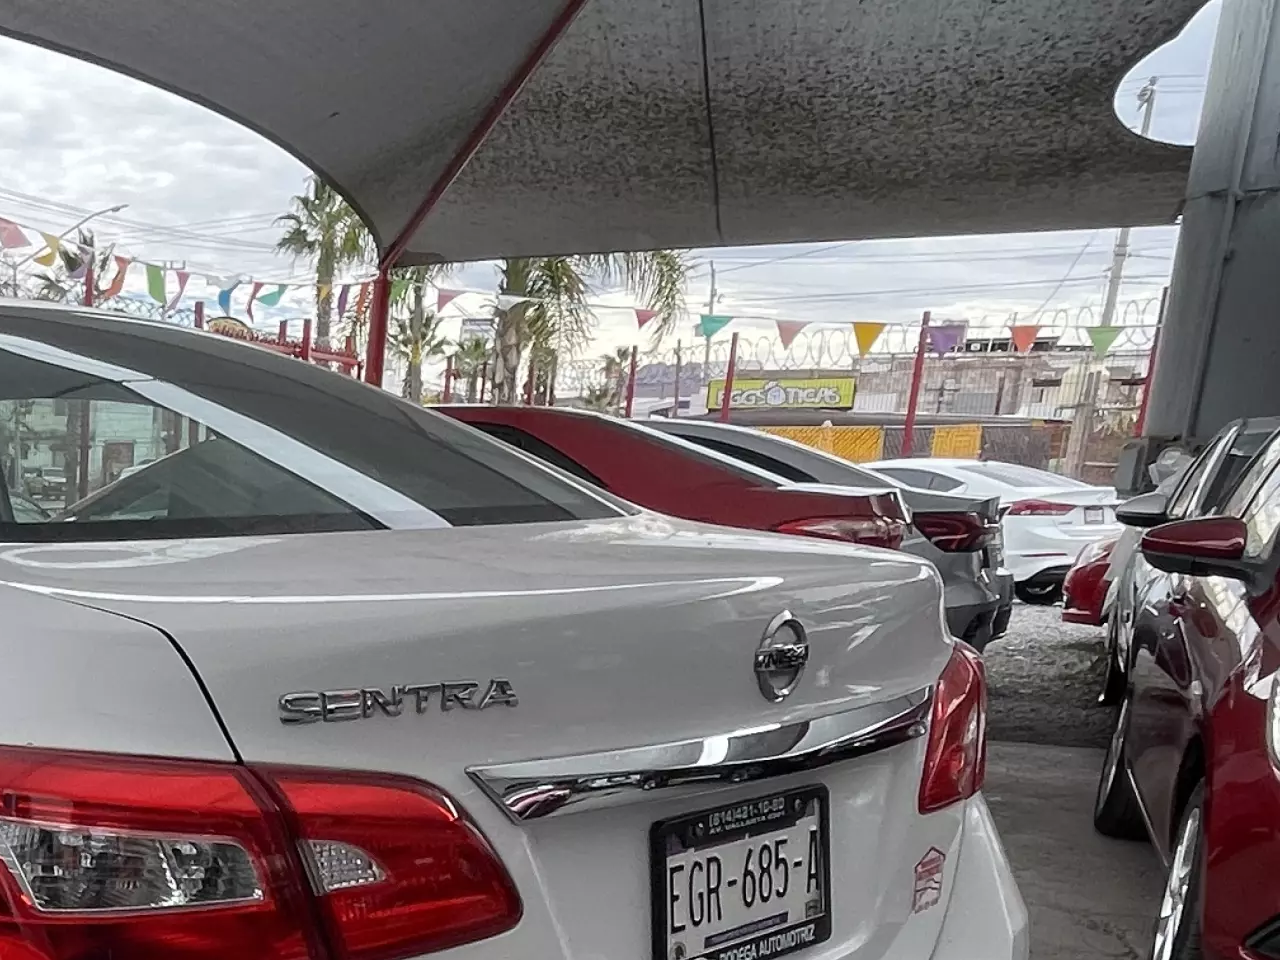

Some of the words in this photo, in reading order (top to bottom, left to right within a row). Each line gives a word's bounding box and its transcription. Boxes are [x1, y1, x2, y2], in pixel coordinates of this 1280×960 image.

[278, 677, 518, 725] SENTRA
[669, 829, 820, 934] EGR-685-A
[759, 923, 816, 957] AUTOMOTRIZ
